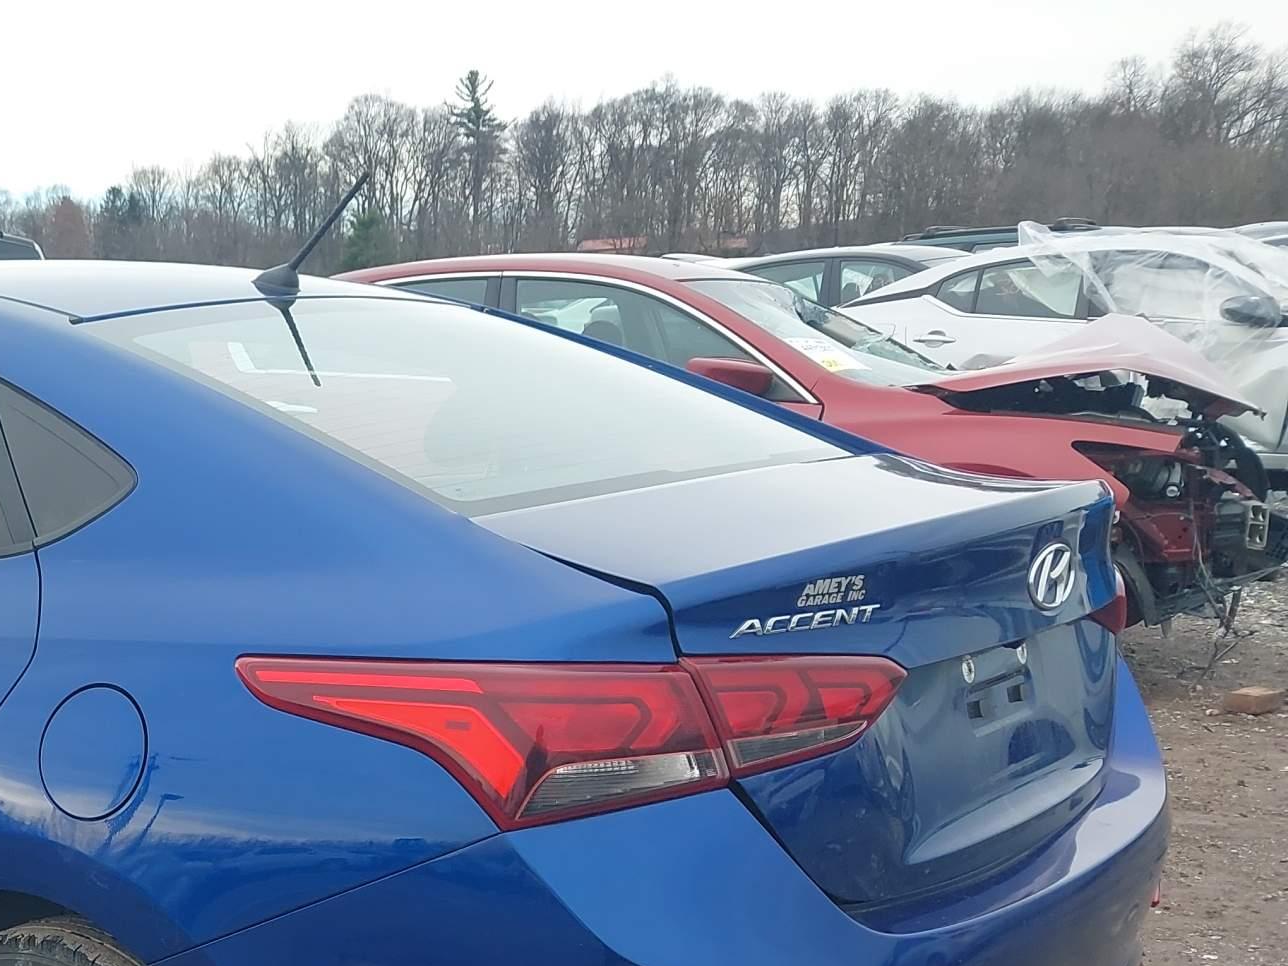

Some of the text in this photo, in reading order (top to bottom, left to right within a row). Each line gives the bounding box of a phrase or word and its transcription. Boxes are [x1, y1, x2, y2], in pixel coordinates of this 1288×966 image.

[802, 575, 865, 596] AMEY'S
[797, 590, 866, 608] GARAGE INC
[728, 603, 881, 640] ACCENT
